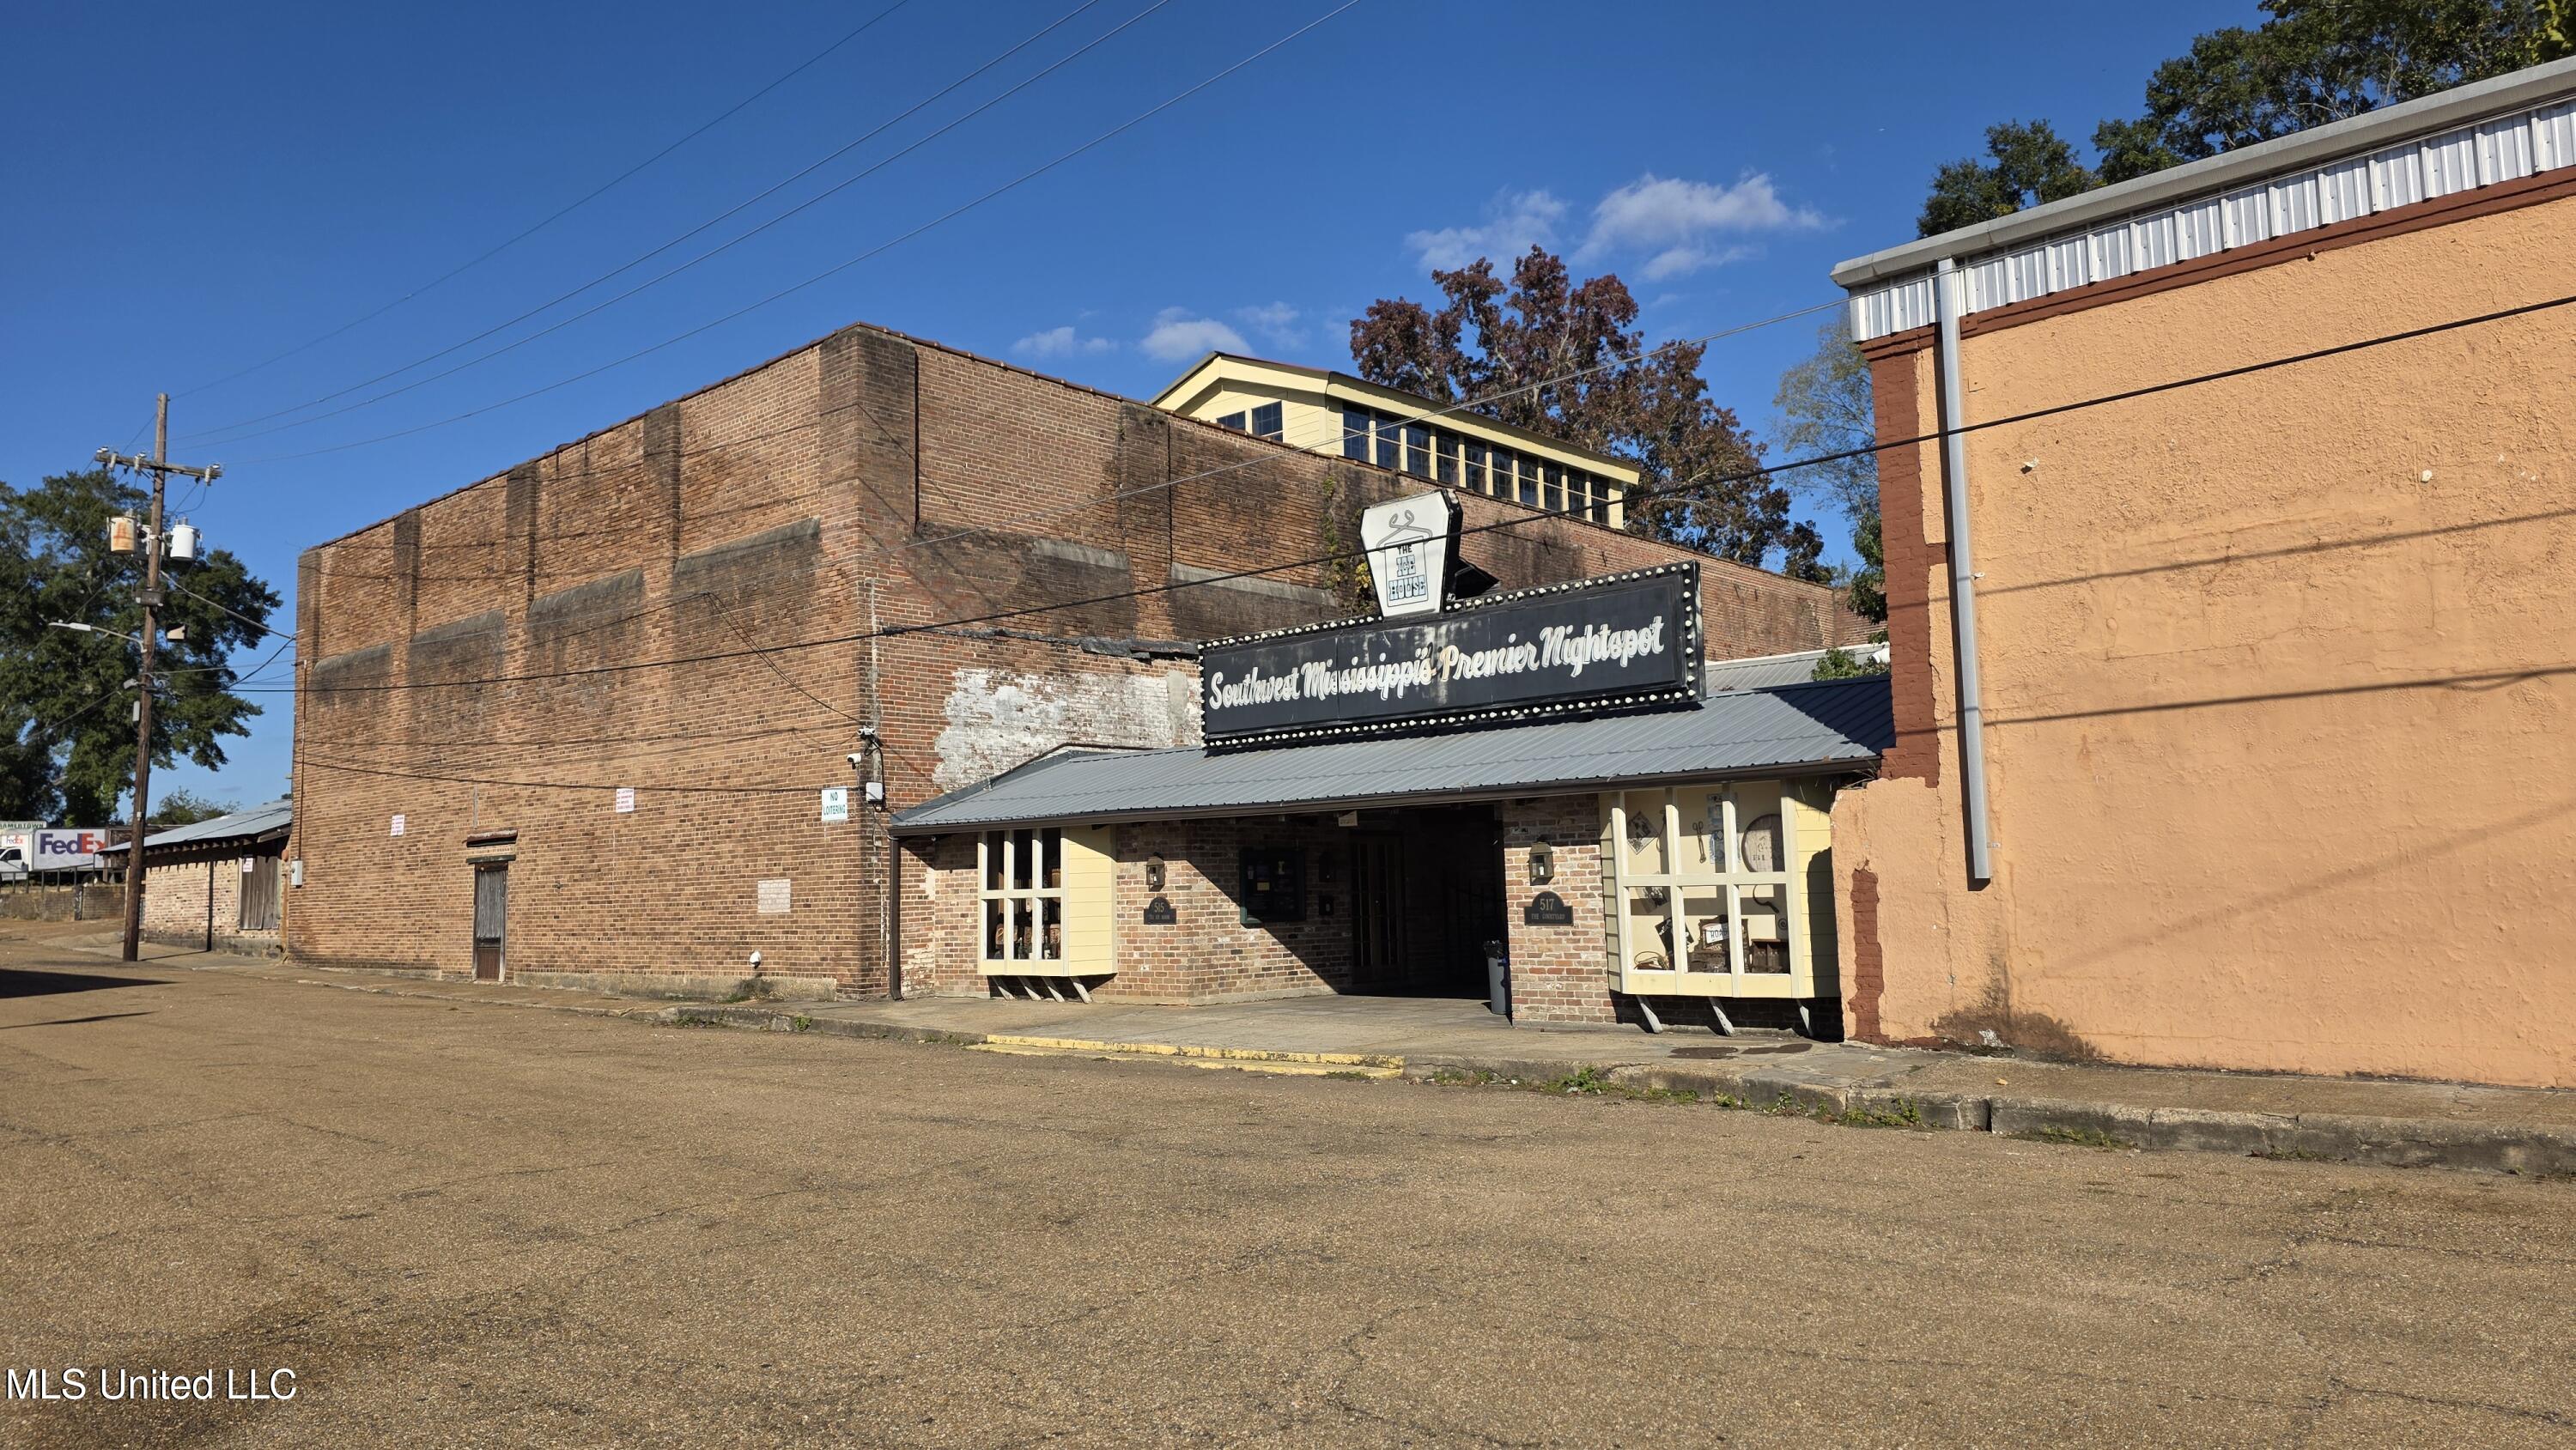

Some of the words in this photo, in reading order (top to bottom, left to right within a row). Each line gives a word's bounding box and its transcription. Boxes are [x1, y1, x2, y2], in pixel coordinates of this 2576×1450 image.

[1397, 543, 1413, 555] THE
[1396, 555, 1416, 577] ICE
[1388, 574, 1426, 601] HOUSE
[1209, 666, 1300, 709] Southwest
[1440, 634, 1540, 682] Premier
[1540, 616, 1664, 677] Nightspot
[830, 792, 838, 801] NO
[823, 804, 846, 815] LOITERING
[39, 833, 106, 855] FedEx
[1154, 901, 1164, 913] 515
[1540, 898, 1554, 911] 517
